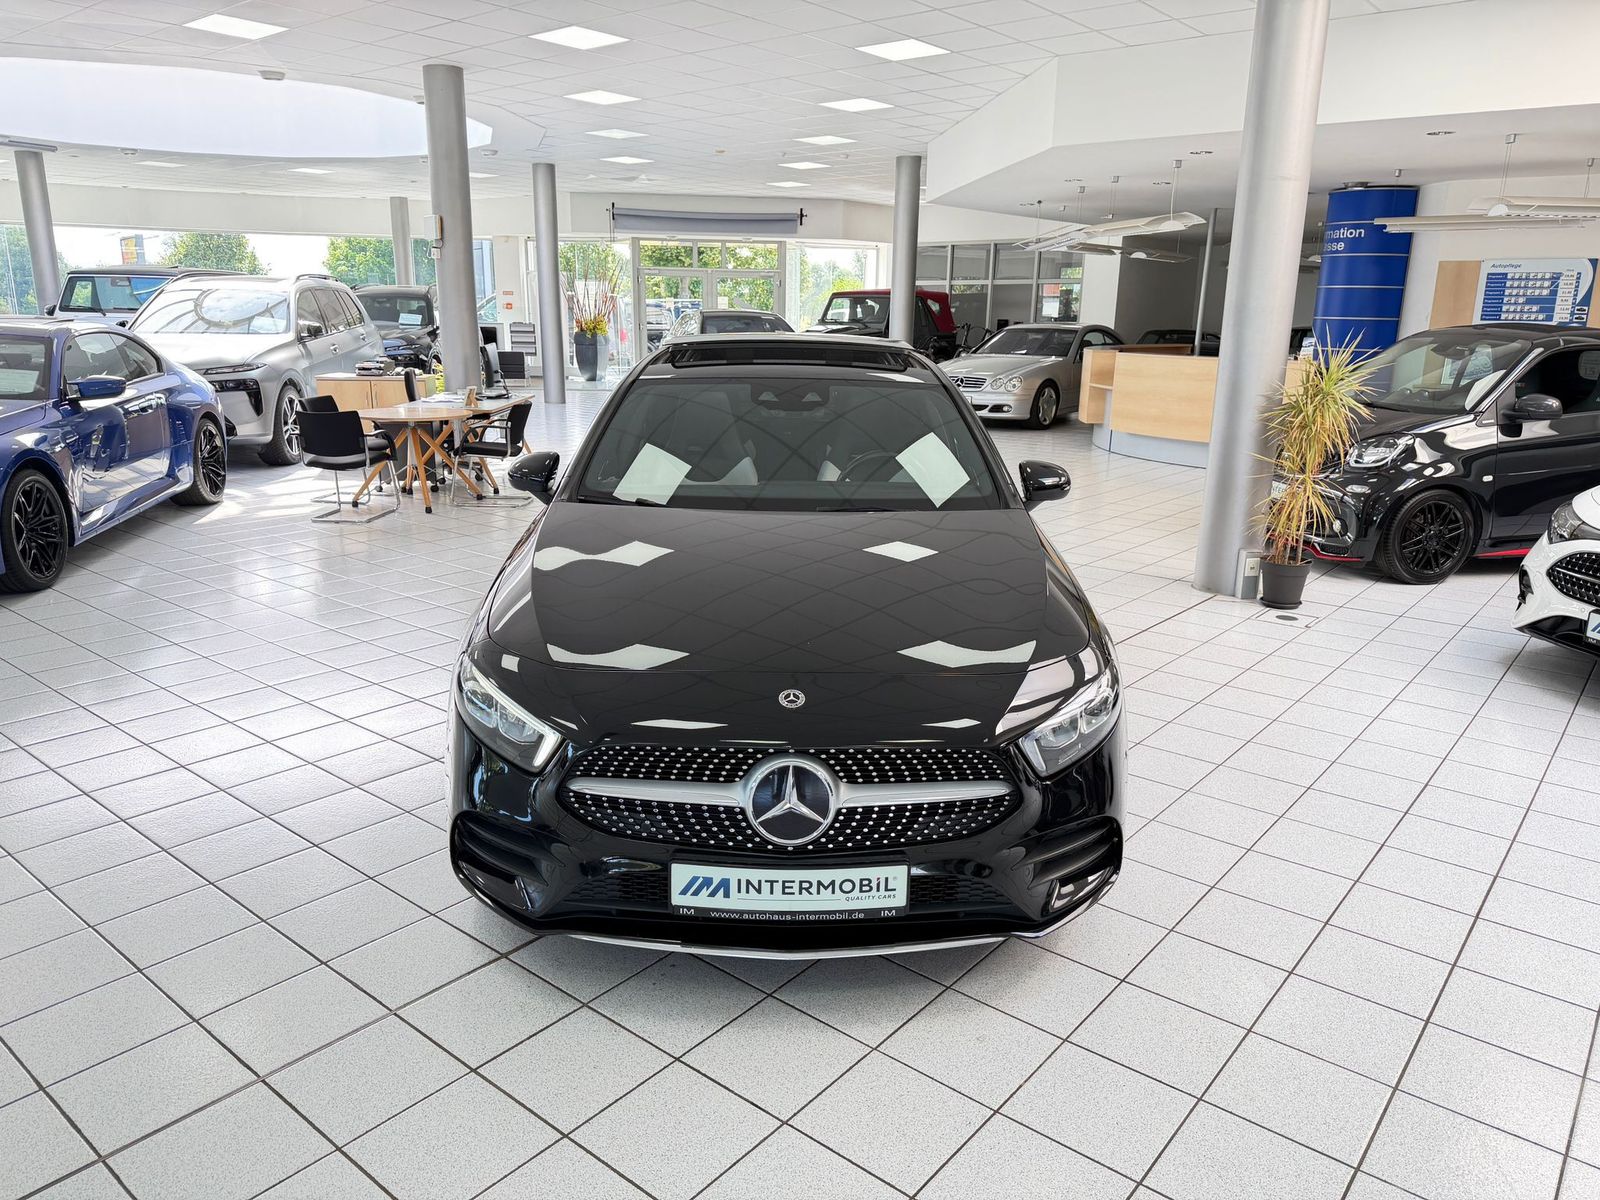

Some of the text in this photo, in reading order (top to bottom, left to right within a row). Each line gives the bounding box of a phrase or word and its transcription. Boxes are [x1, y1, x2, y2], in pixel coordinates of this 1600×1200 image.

[679, 907, 695, 915] IM
[880, 909, 896, 917] IM
[710, 910, 865, 921] www.autohaus-intermobil.de
